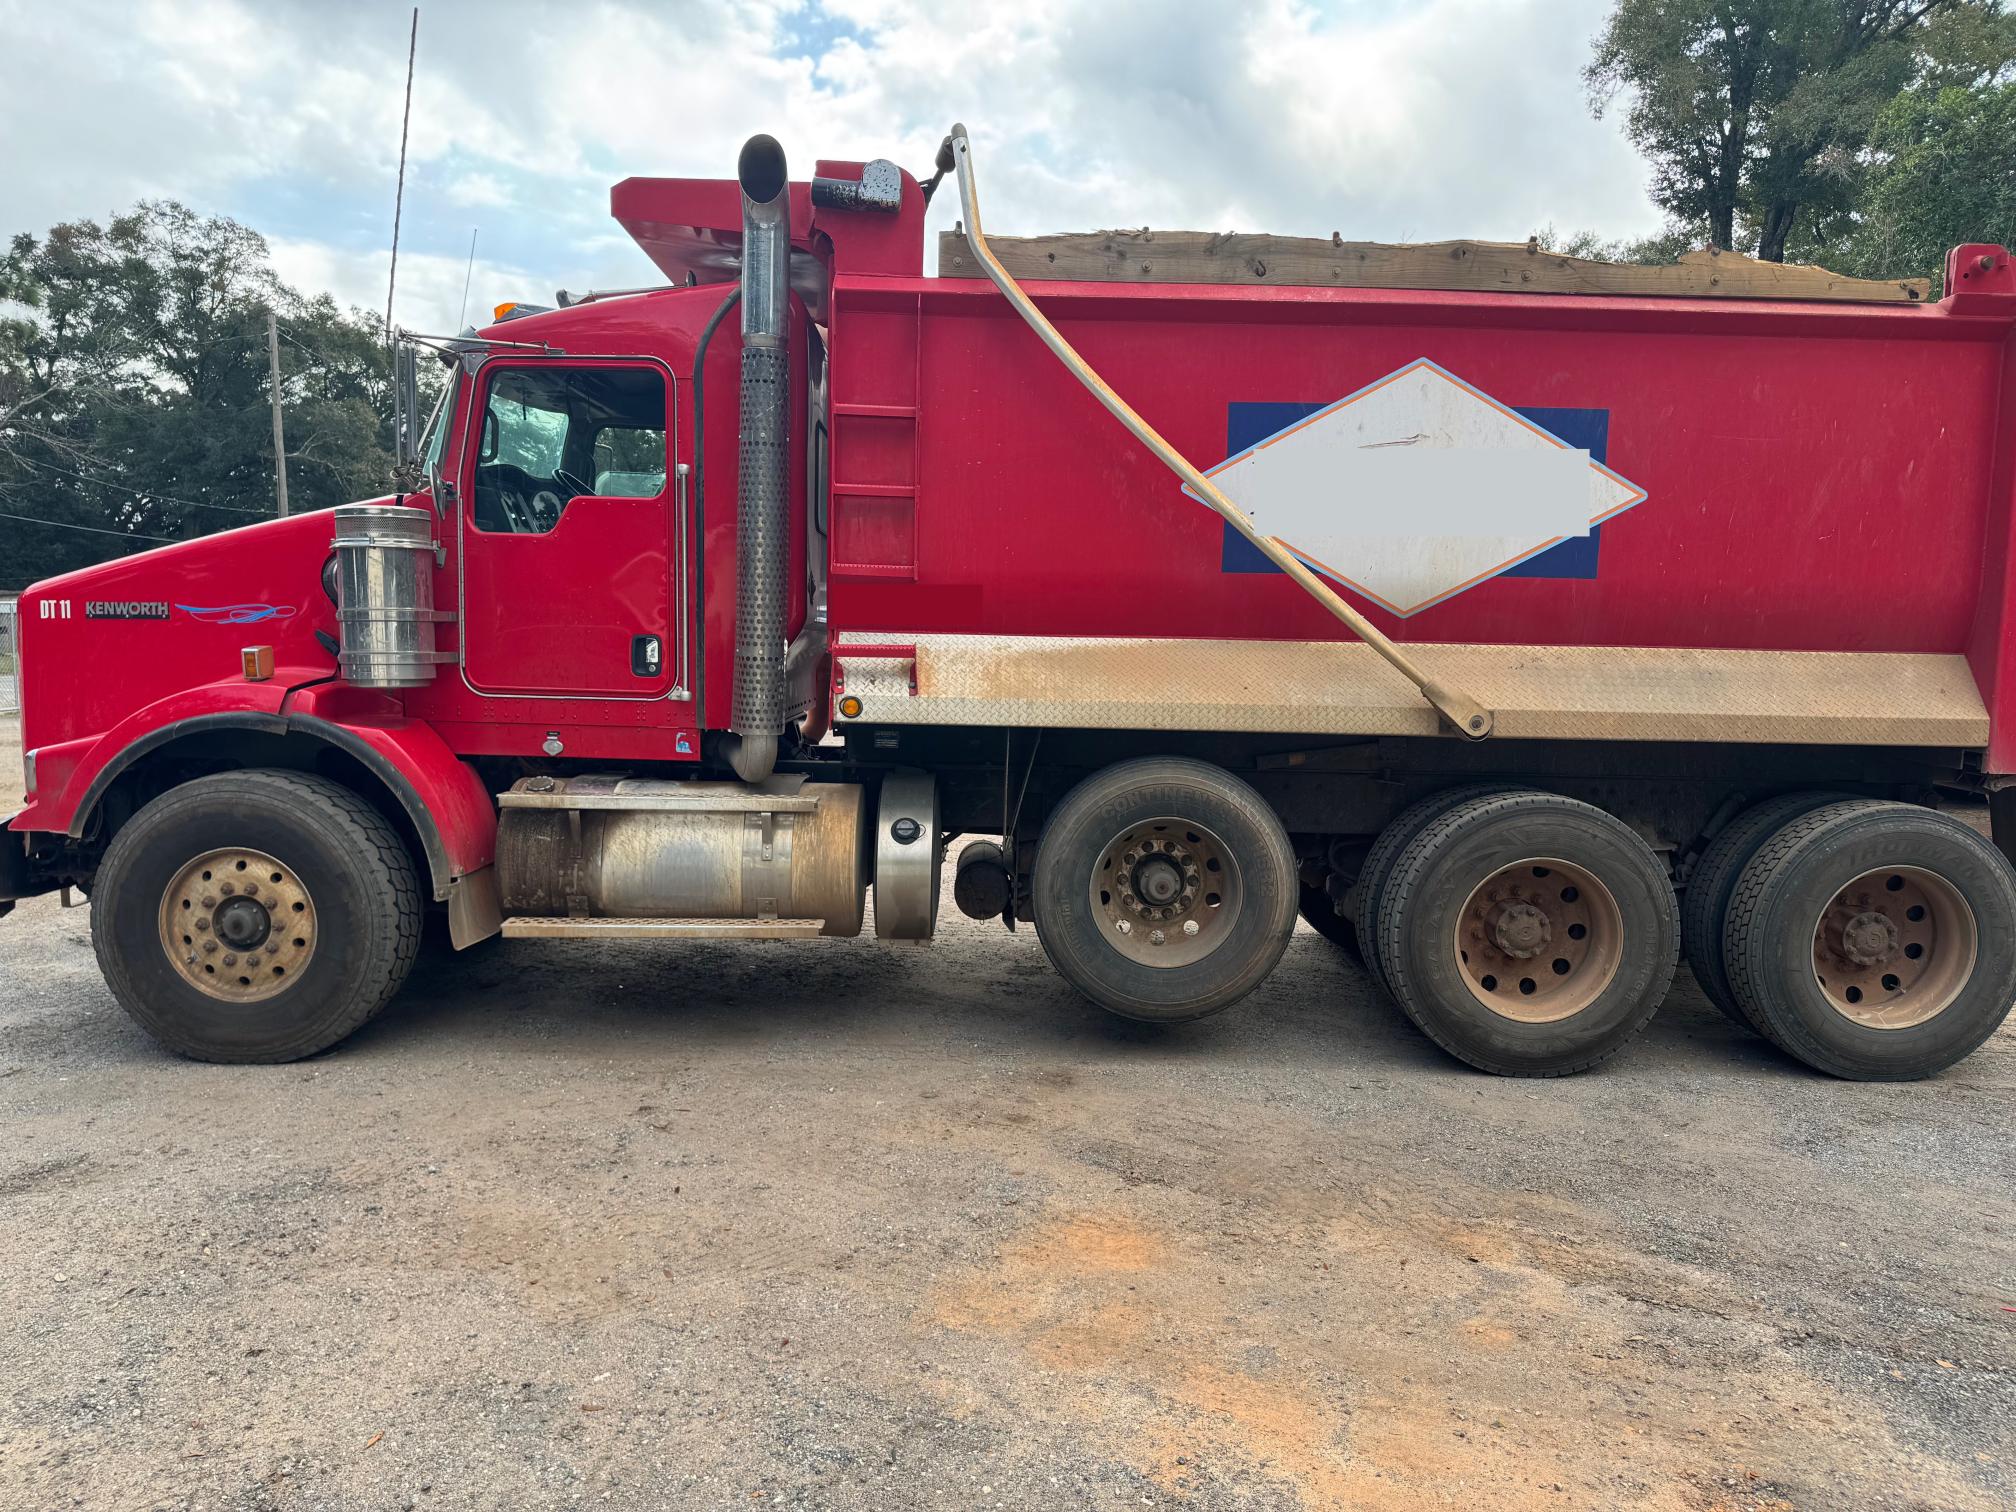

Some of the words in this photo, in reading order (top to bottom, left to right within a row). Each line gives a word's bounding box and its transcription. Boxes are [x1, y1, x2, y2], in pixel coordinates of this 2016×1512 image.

[40, 599, 56, 619] DT
[59, 599, 71, 619] 11
[85, 601, 169, 616] KENWORTH
